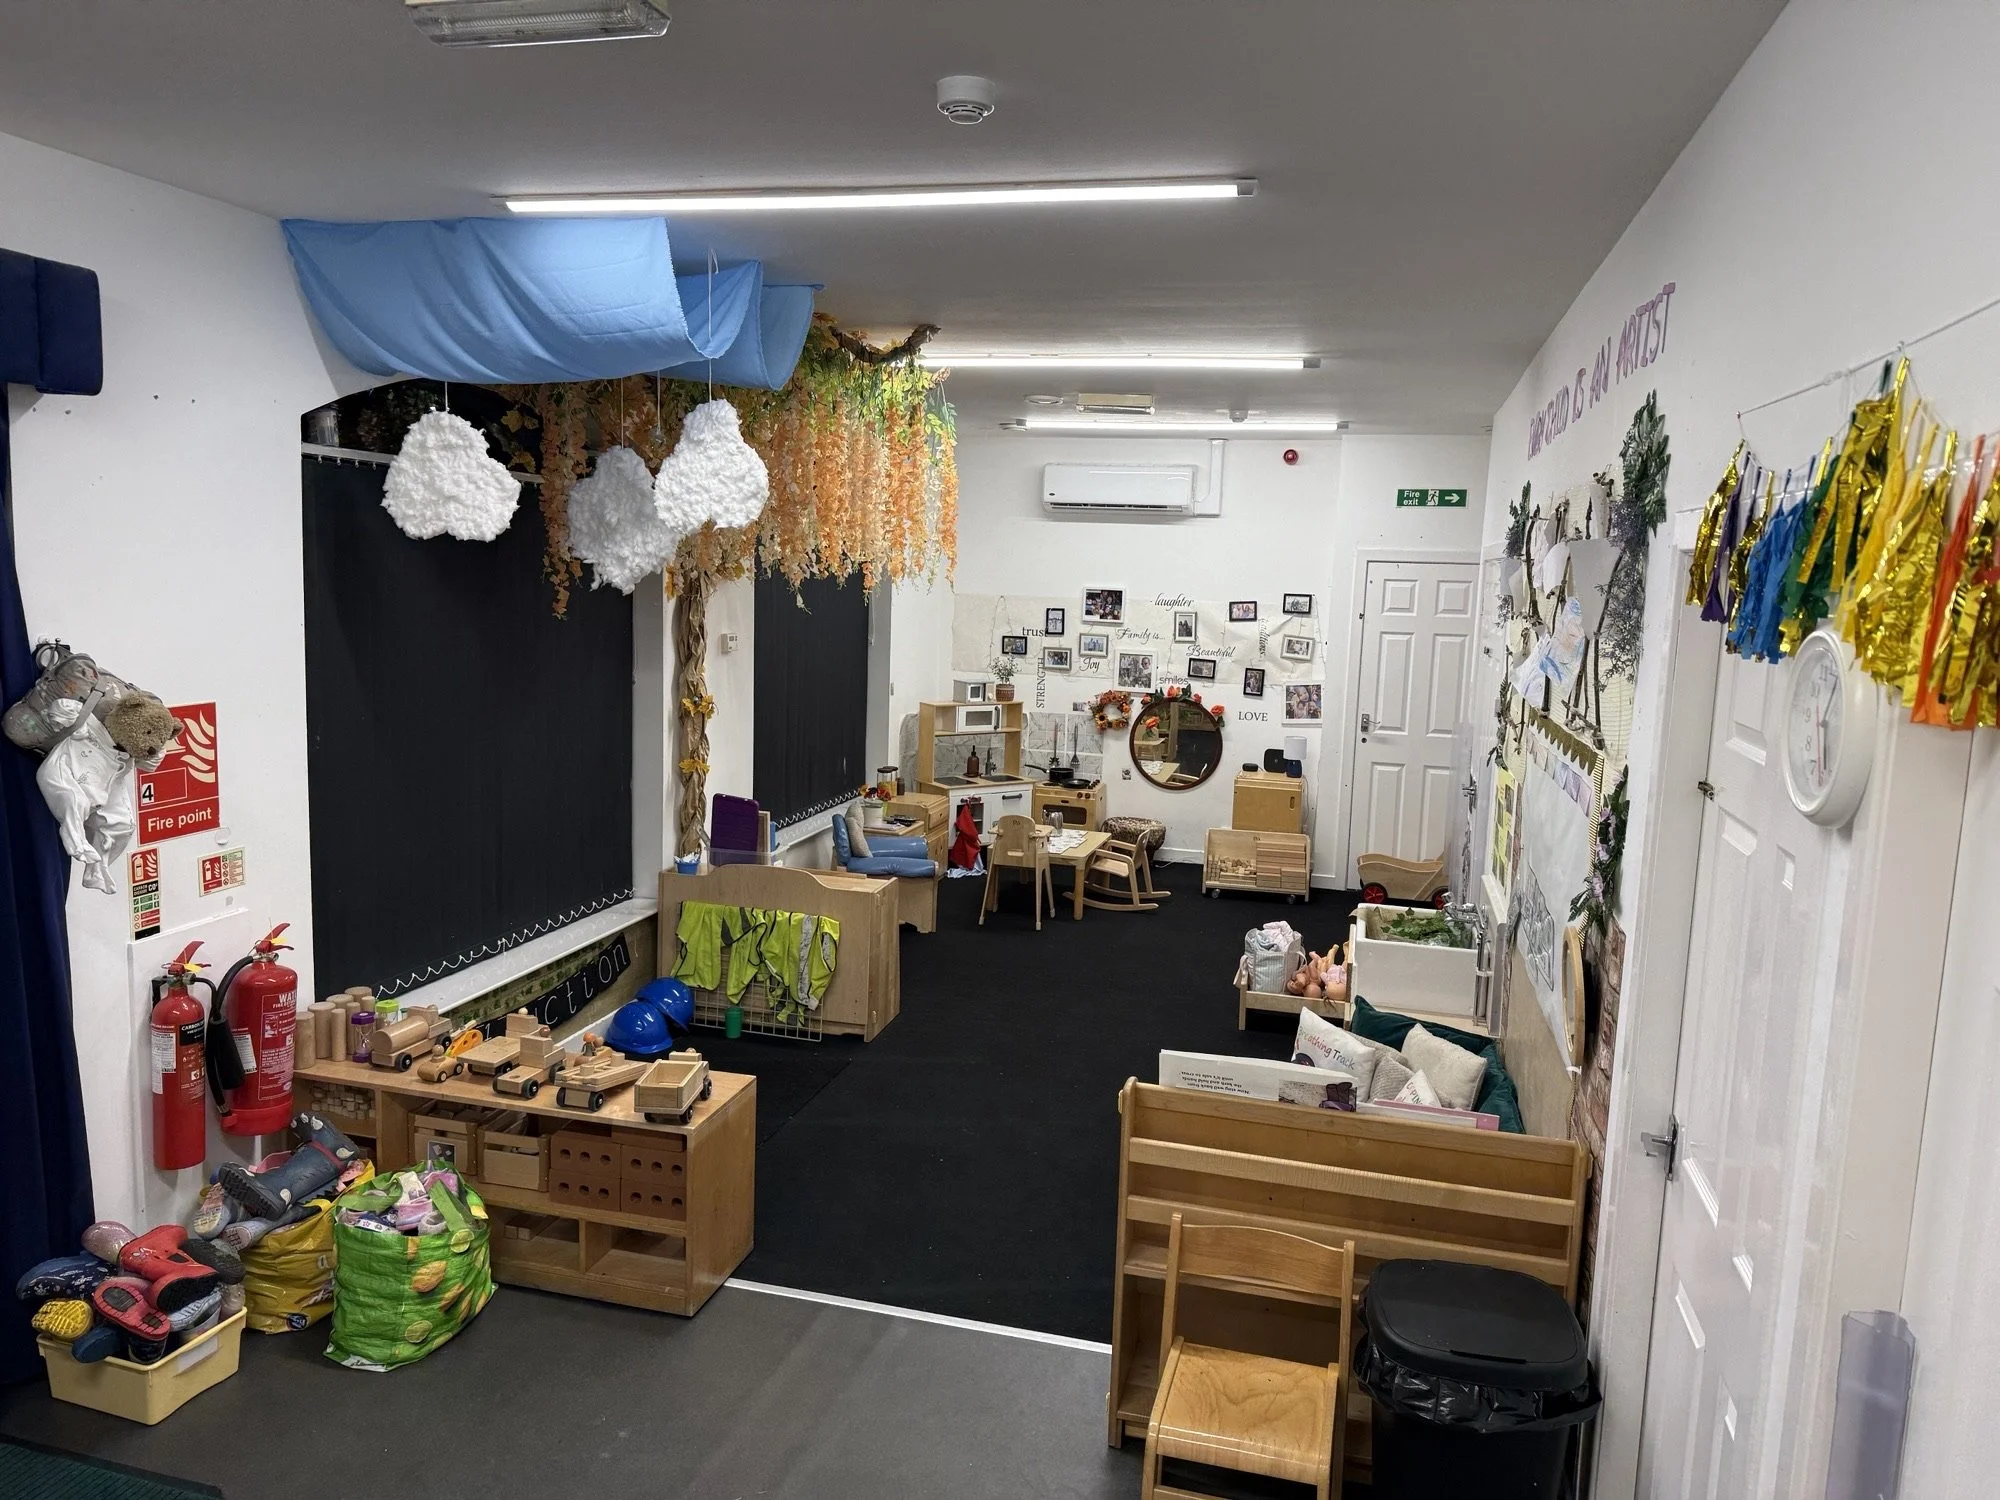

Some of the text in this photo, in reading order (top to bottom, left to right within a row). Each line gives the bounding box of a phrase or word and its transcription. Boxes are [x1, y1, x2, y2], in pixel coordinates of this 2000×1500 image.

[1589, 336, 1611, 409] AN
[1616, 282, 1676, 385] ARTIST
[1403, 498, 1418, 506] exit
[1404, 490, 1420, 498] Fire
[1150, 593, 1194, 611] laughter
[1116, 628, 1151, 645] Family
[1186, 644, 1236, 658] Beautiful
[1036, 657, 1046, 709] STRENGTH
[1159, 676, 1189, 685] smiles
[1238, 711, 1268, 722] LOVE
[142, 784, 154, 801] 4
[147, 807, 212, 833] Fire point
[1332, 1049, 1356, 1070] Track
